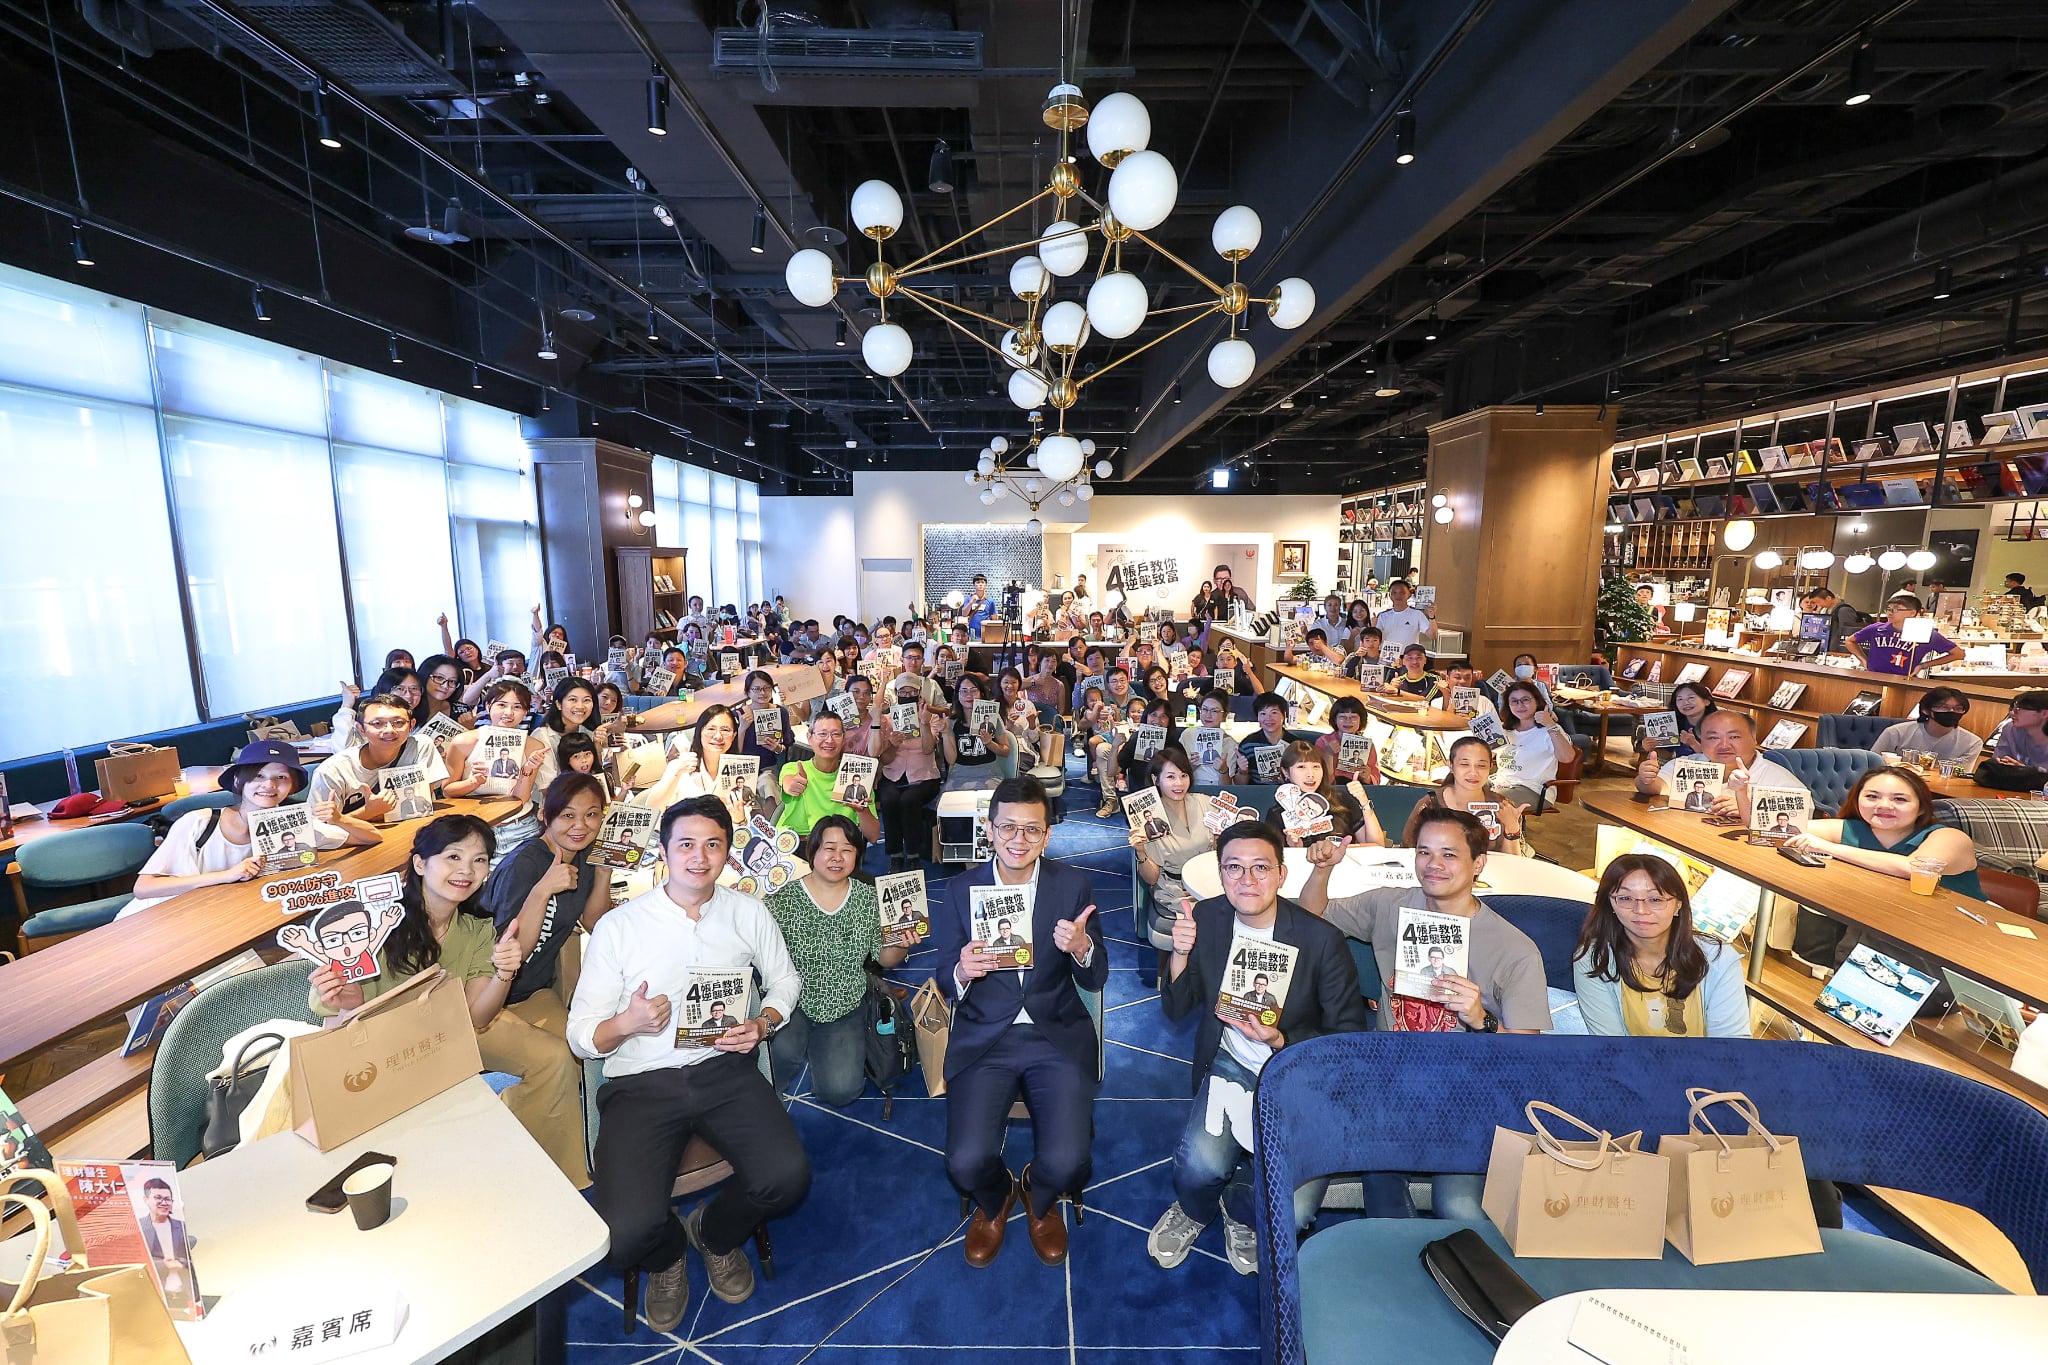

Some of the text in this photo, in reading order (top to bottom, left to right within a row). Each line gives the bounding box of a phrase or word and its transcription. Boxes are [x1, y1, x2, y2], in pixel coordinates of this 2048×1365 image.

[267, 874, 338, 898] 90%防守
[287, 886, 356, 910] 10%進攻
[343, 966, 364, 980] 90
[385, 1032, 448, 1070] 理財醫生
[62, 1166, 108, 1178] 理財醫生
[78, 1179, 126, 1195] 陳大仁
[1576, 1196, 1636, 1210] 理財醫生
[290, 1308, 374, 1351] 嘉賓席
